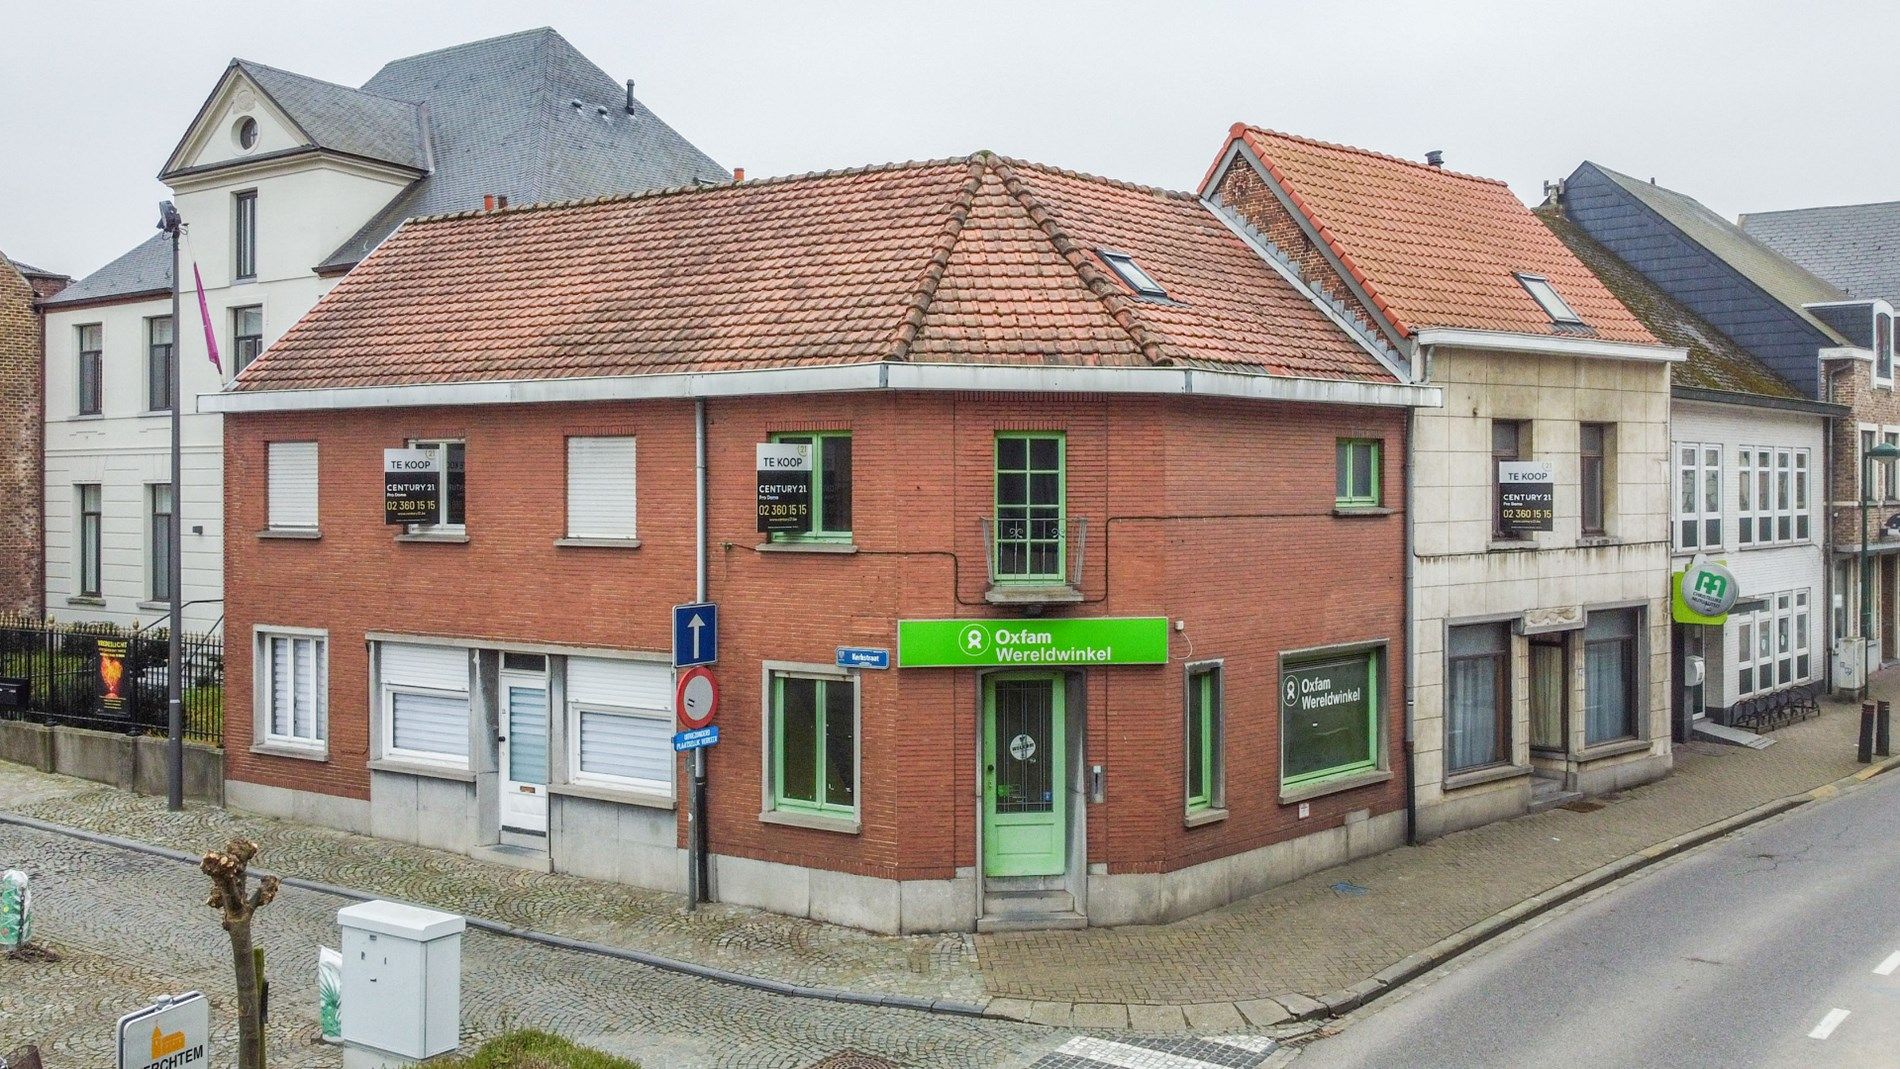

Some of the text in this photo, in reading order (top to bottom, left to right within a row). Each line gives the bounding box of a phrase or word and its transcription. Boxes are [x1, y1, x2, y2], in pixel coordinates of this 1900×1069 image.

[391, 460, 431, 469] TE KOOP
[764, 457, 803, 467] TE KOOP
[1522, 473, 1548, 481] KOOP
[387, 484, 426, 492] CENTURY
[759, 485, 797, 493] CENTURY
[387, 501, 435, 510] 02 360 15 15
[759, 504, 807, 515] 02 360 15 15
[1503, 510, 1552, 518] 02 360 15 15
[995, 629, 1052, 646] Oxfam
[851, 652, 880, 662] Kerkstraat
[996, 646, 1112, 662] Wereldwinkel
[1301, 677, 1331, 693] Oxfam
[1301, 687, 1361, 710] Wereldwinkel
